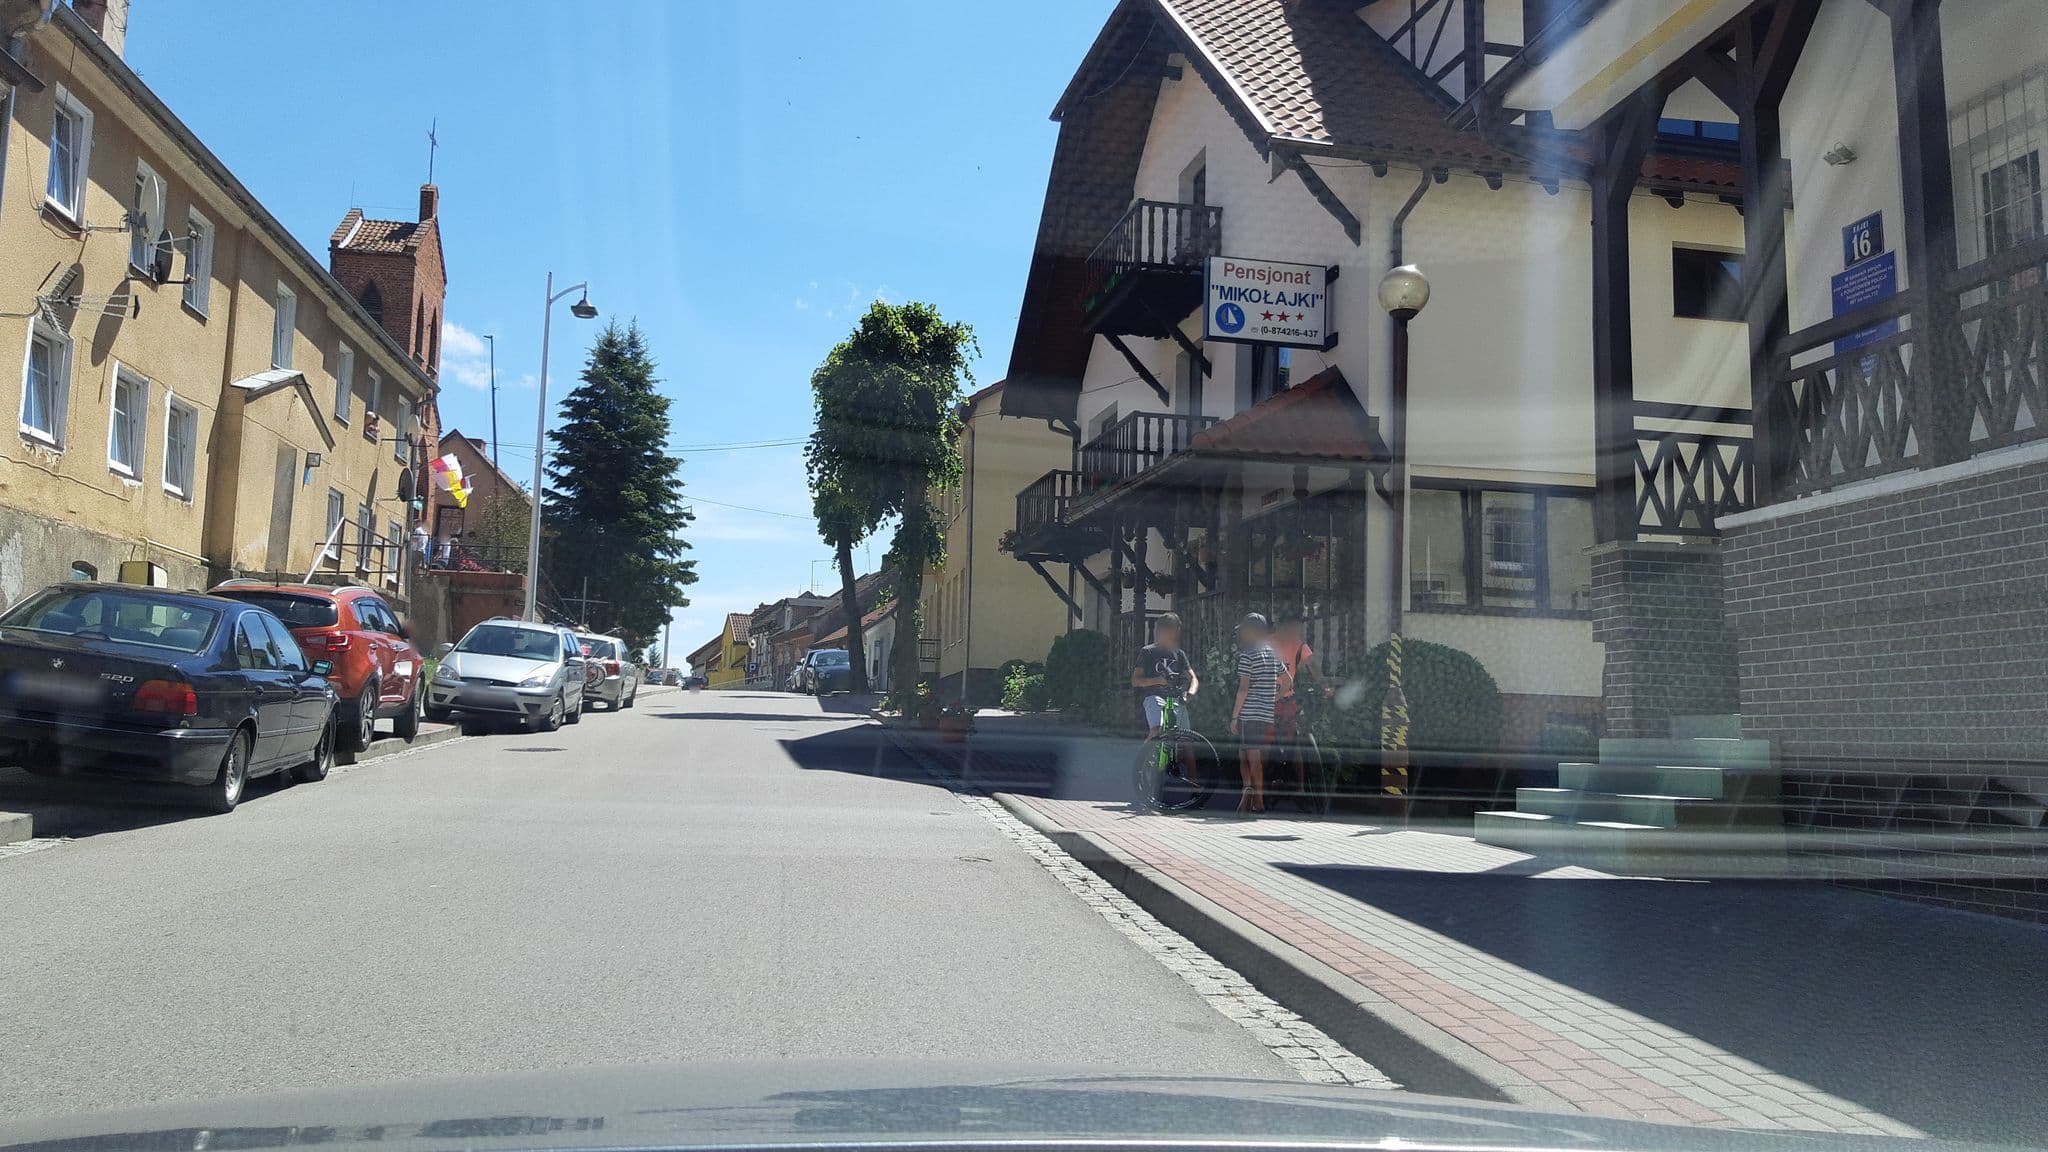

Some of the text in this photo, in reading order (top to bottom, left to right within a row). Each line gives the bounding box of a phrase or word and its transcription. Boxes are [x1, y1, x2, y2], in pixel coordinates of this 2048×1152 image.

[1852, 230, 1871, 260] 16
[1223, 262, 1311, 285] Pensjonat
[1211, 284, 1323, 308] "MIKOŁAJKI"
